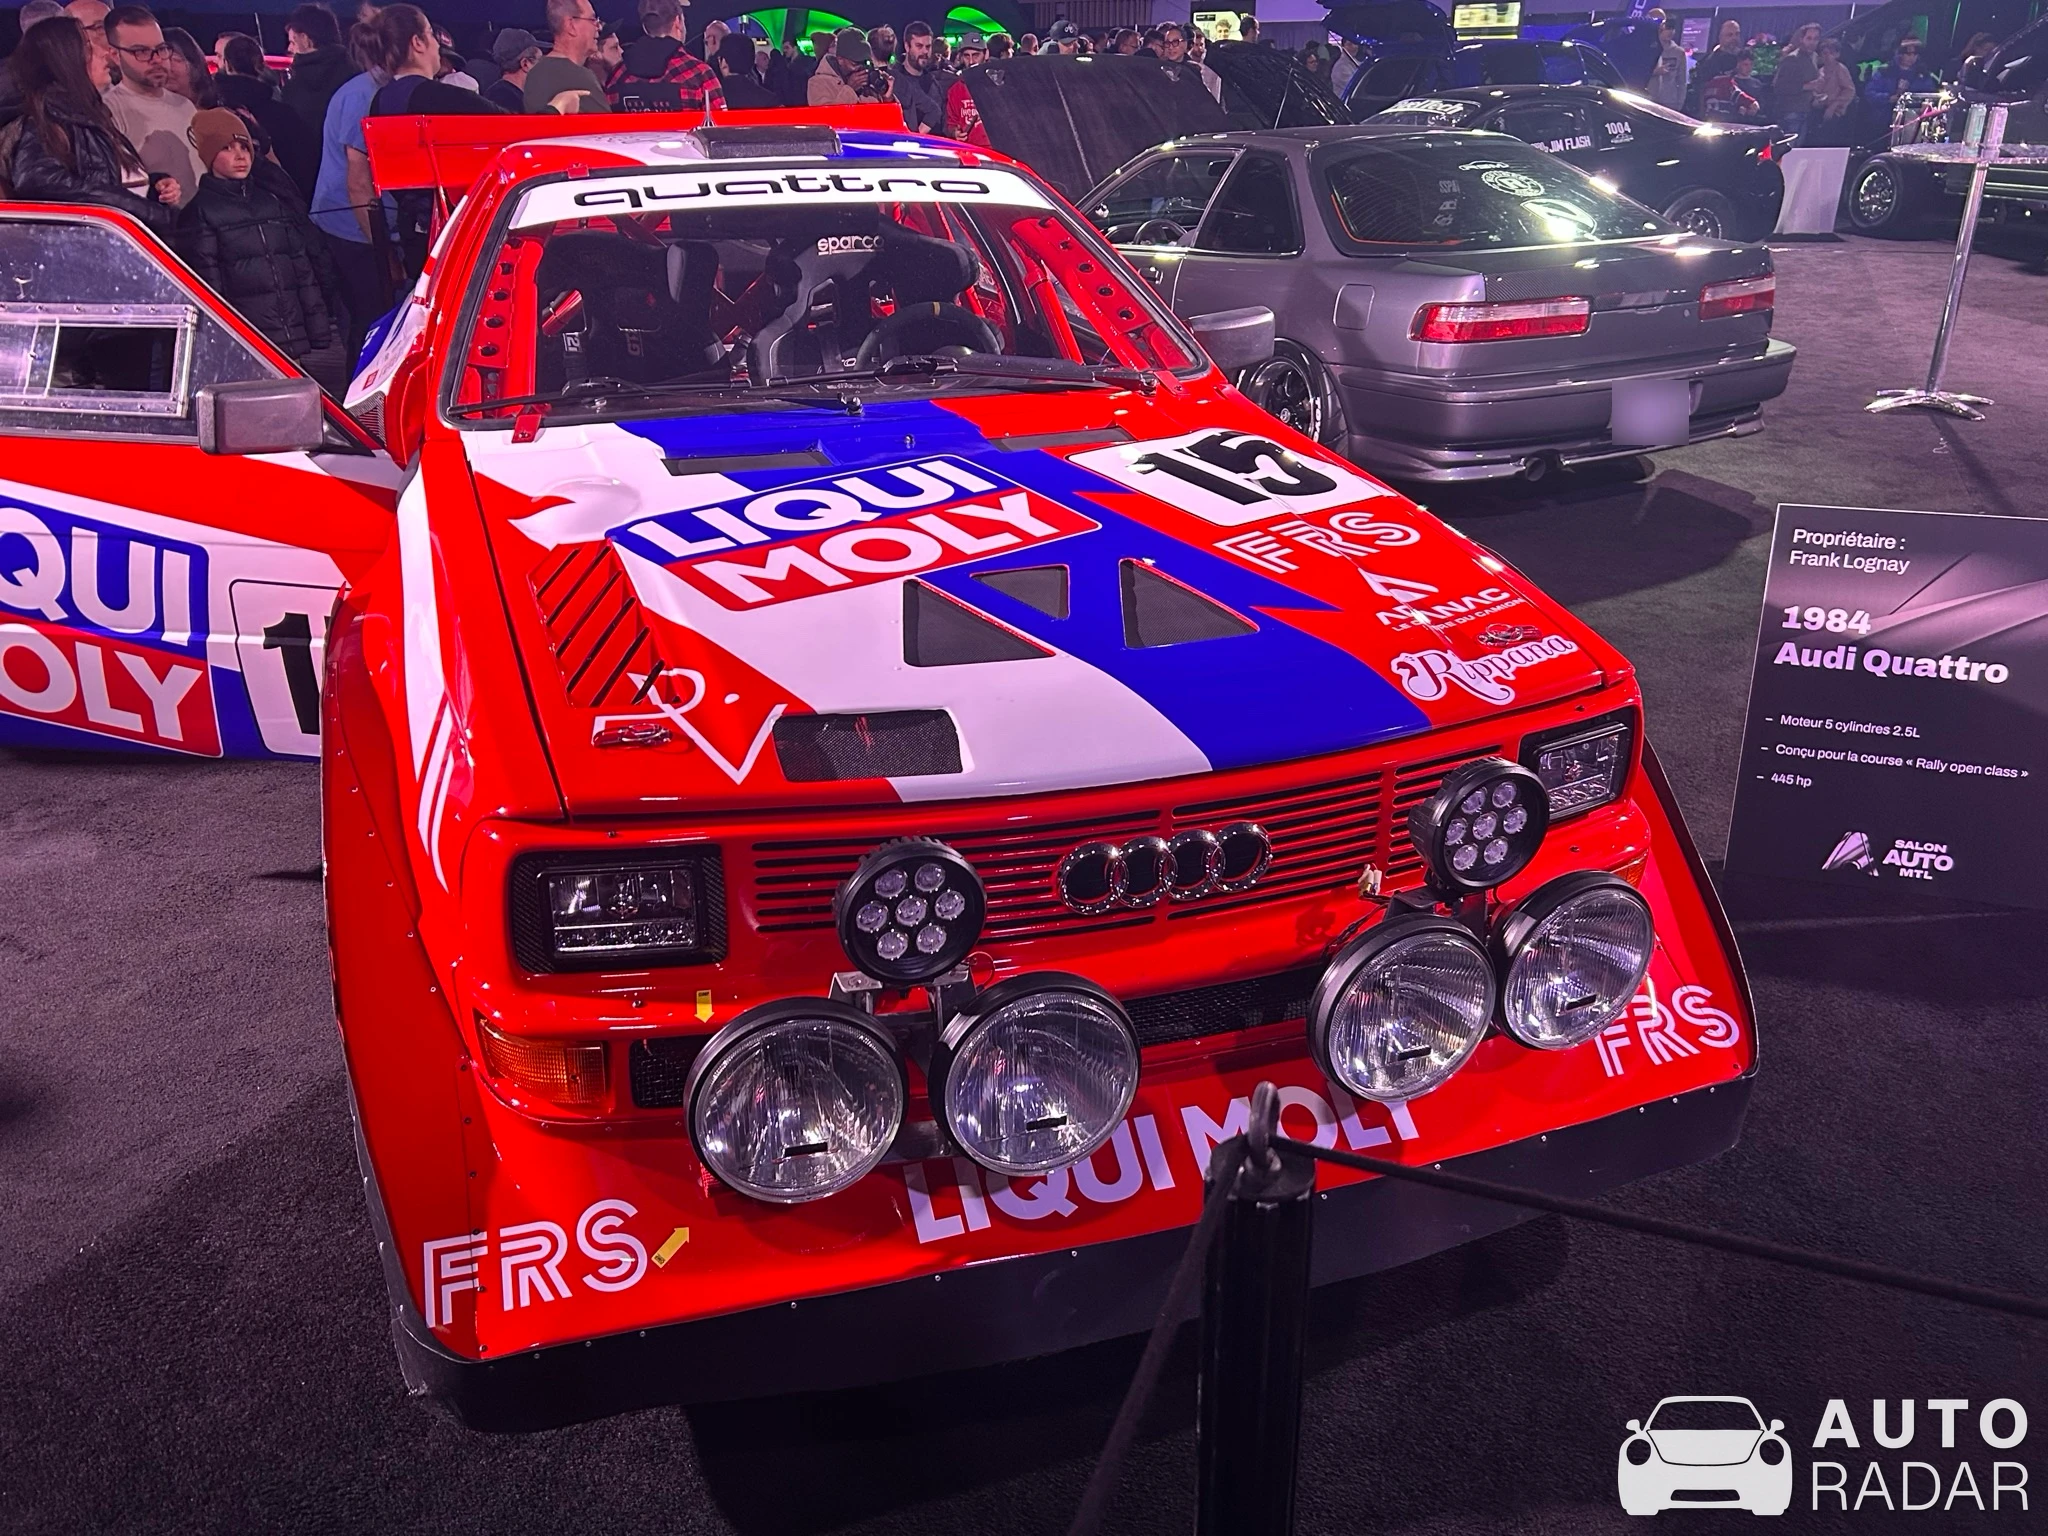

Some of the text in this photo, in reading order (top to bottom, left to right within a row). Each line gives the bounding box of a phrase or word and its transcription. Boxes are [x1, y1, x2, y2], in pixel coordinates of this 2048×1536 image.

[1549, 139, 1564, 153] JIM
[1564, 135, 1592, 150] FLASH
[1604, 121, 1632, 135] 1004
[573, 174, 991, 208] quattro
[818, 235, 884, 254] sparco
[1311, 396, 1322, 443] TOYO
[1133, 430, 1338, 506] 15
[628, 460, 998, 558] LIQUI
[691, 491, 1061, 604] MOLY
[1212, 511, 1421, 574] FRS
[1792, 528, 1897, 549] Propriétaire
[1789, 550, 1911, 575] Frank Lognay
[1391, 622, 1412, 632] LE
[1454, 614, 1475, 625] DU
[1474, 597, 1526, 618] CAMION
[1782, 605, 1872, 635] 1984
[262, 612, 330, 735] 1
[1395, 636, 1573, 701] Rippana
[1773, 642, 2010, 684] Audi Quattro
[1780, 714, 1921, 738] Moteur 5 cylindres 2.5L
[1775, 744, 1815, 759] Conçu
[1817, 748, 1846, 762] pour
[1847, 751, 1859, 762] la
[1860, 754, 1903, 767] course
[1915, 758, 1948, 773] Rally
[1949, 763, 1982, 777] open
[1984, 765, 2018, 778] class
[1771, 772, 1812, 788] 445 hp
[1882, 849, 1954, 872] AUTO
[1894, 838, 1948, 854] SALON
[1898, 867, 1934, 881] MTL
[1594, 984, 1740, 1078] FRS
[902, 1114, 1176, 1244] LIQUI
[422, 1198, 649, 1328] FRS
